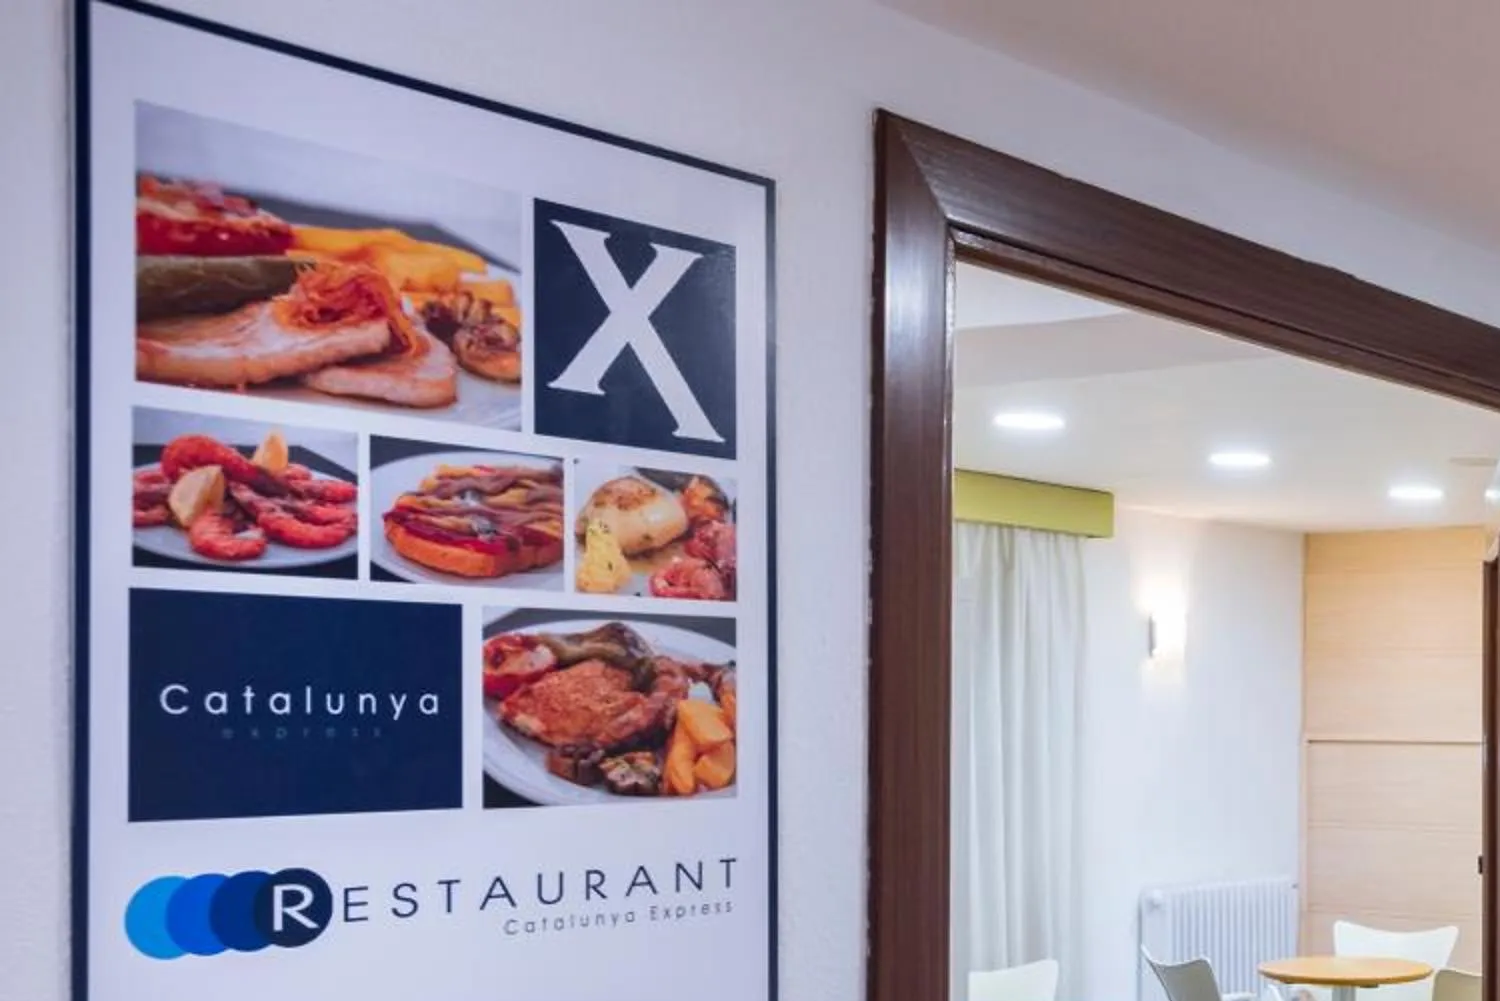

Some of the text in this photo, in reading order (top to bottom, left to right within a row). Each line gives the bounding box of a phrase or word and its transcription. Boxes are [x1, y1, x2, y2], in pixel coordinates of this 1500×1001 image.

[547, 218, 727, 444] X
[158, 683, 441, 720] Catalunya
[271, 857, 737, 932] RESTAURANT
[503, 900, 733, 936] Catalunya Express
